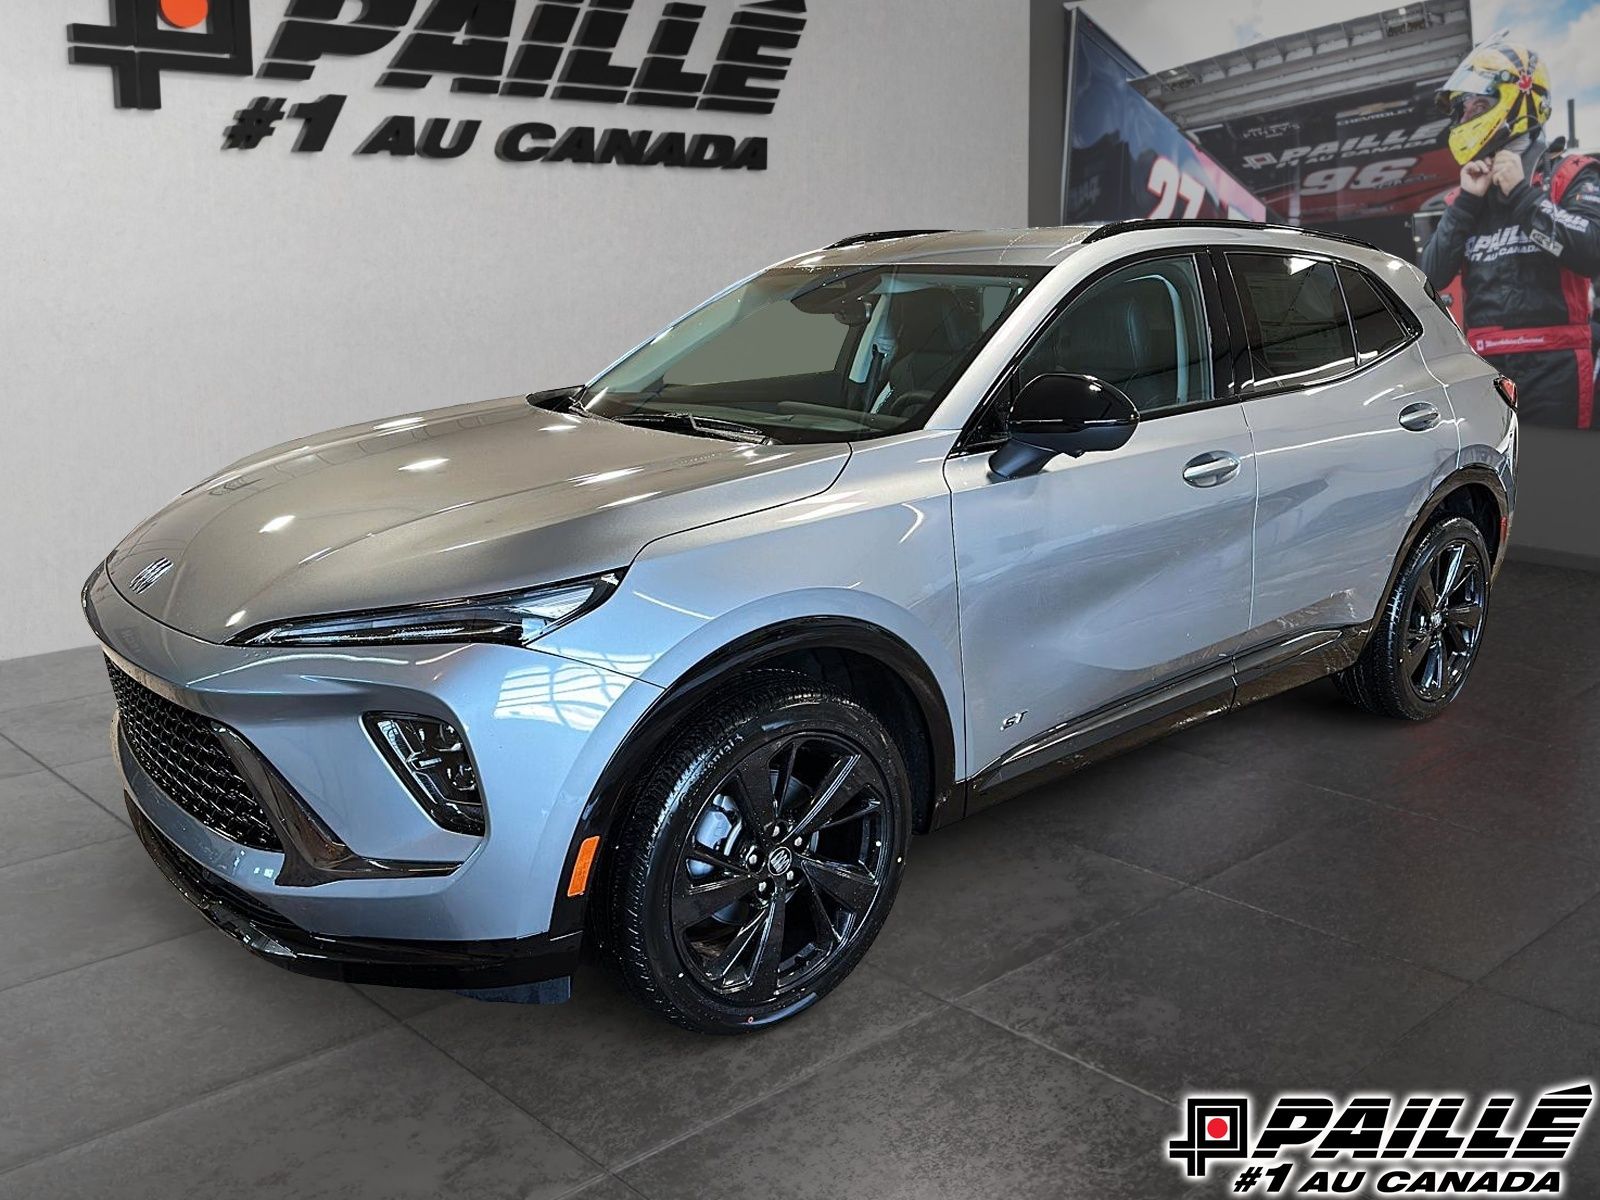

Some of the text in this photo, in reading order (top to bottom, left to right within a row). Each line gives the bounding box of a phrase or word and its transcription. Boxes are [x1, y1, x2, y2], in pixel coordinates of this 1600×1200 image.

[220, 94, 768, 170] #1 AU CANADA
[1341, 138, 1437, 158] CANADA
[1300, 157, 1418, 196] 96
